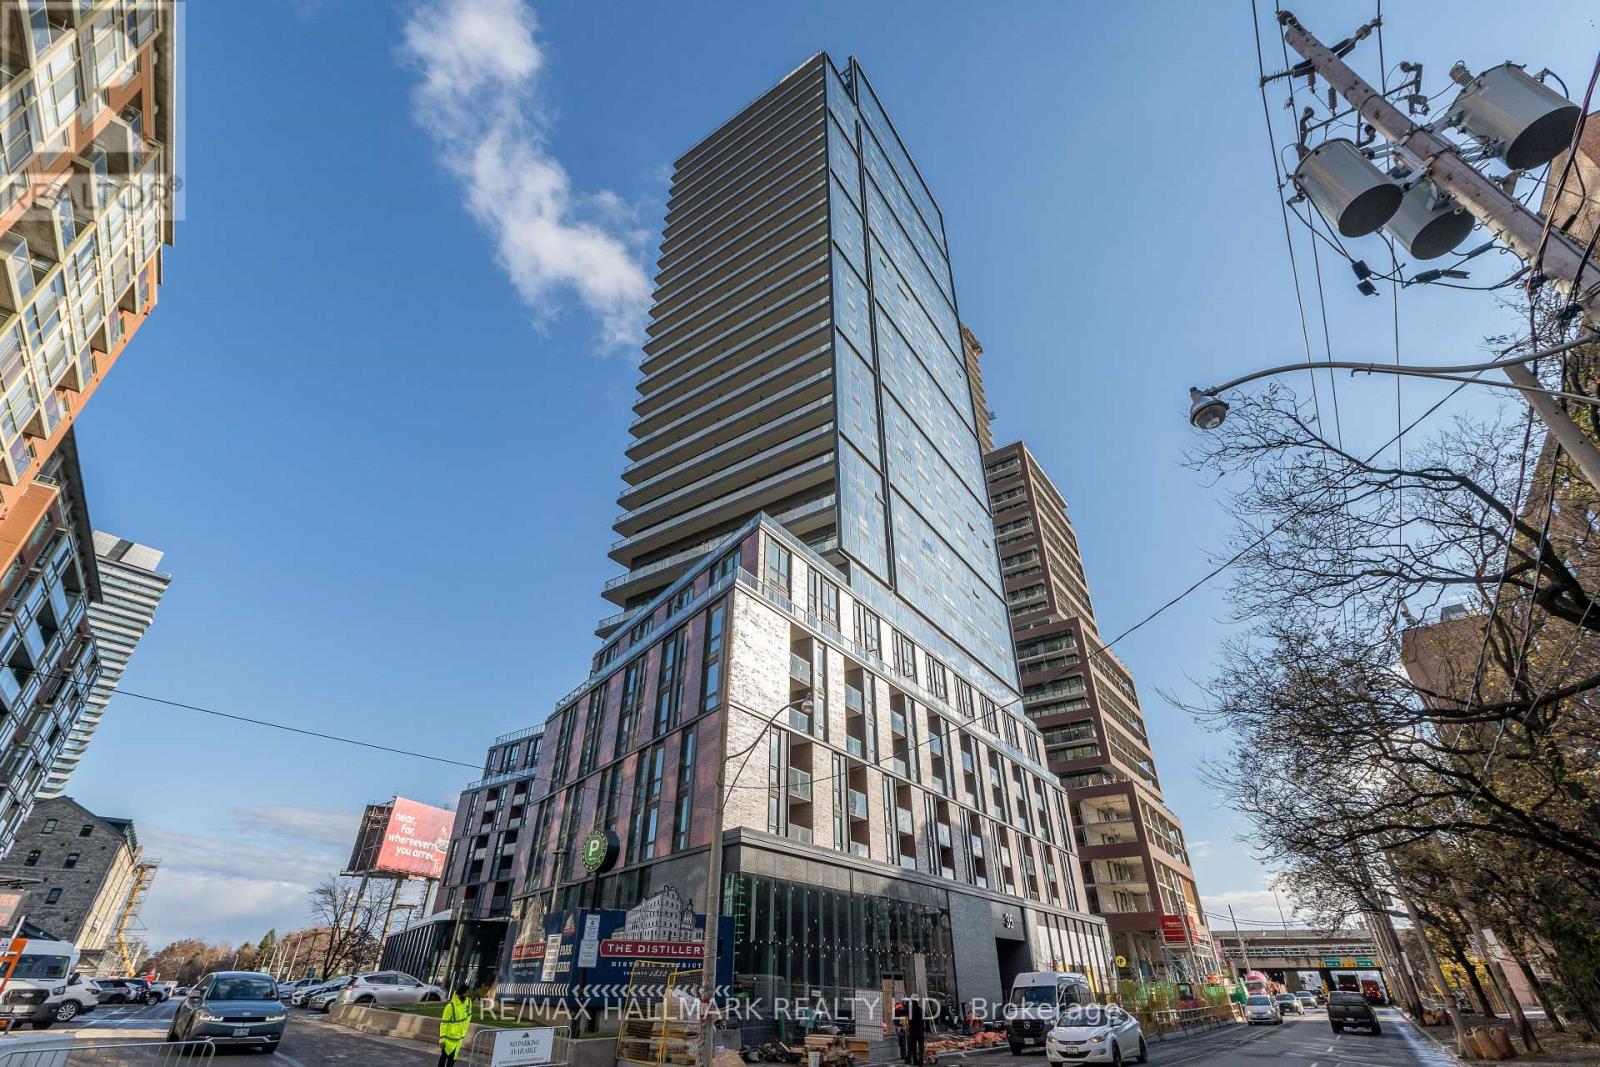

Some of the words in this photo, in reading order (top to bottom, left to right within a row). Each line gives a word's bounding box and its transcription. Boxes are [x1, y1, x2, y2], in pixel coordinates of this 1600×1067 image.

[395, 845, 411, 856] you
[589, 839, 600, 857] P
[608, 943, 633, 953] THE
